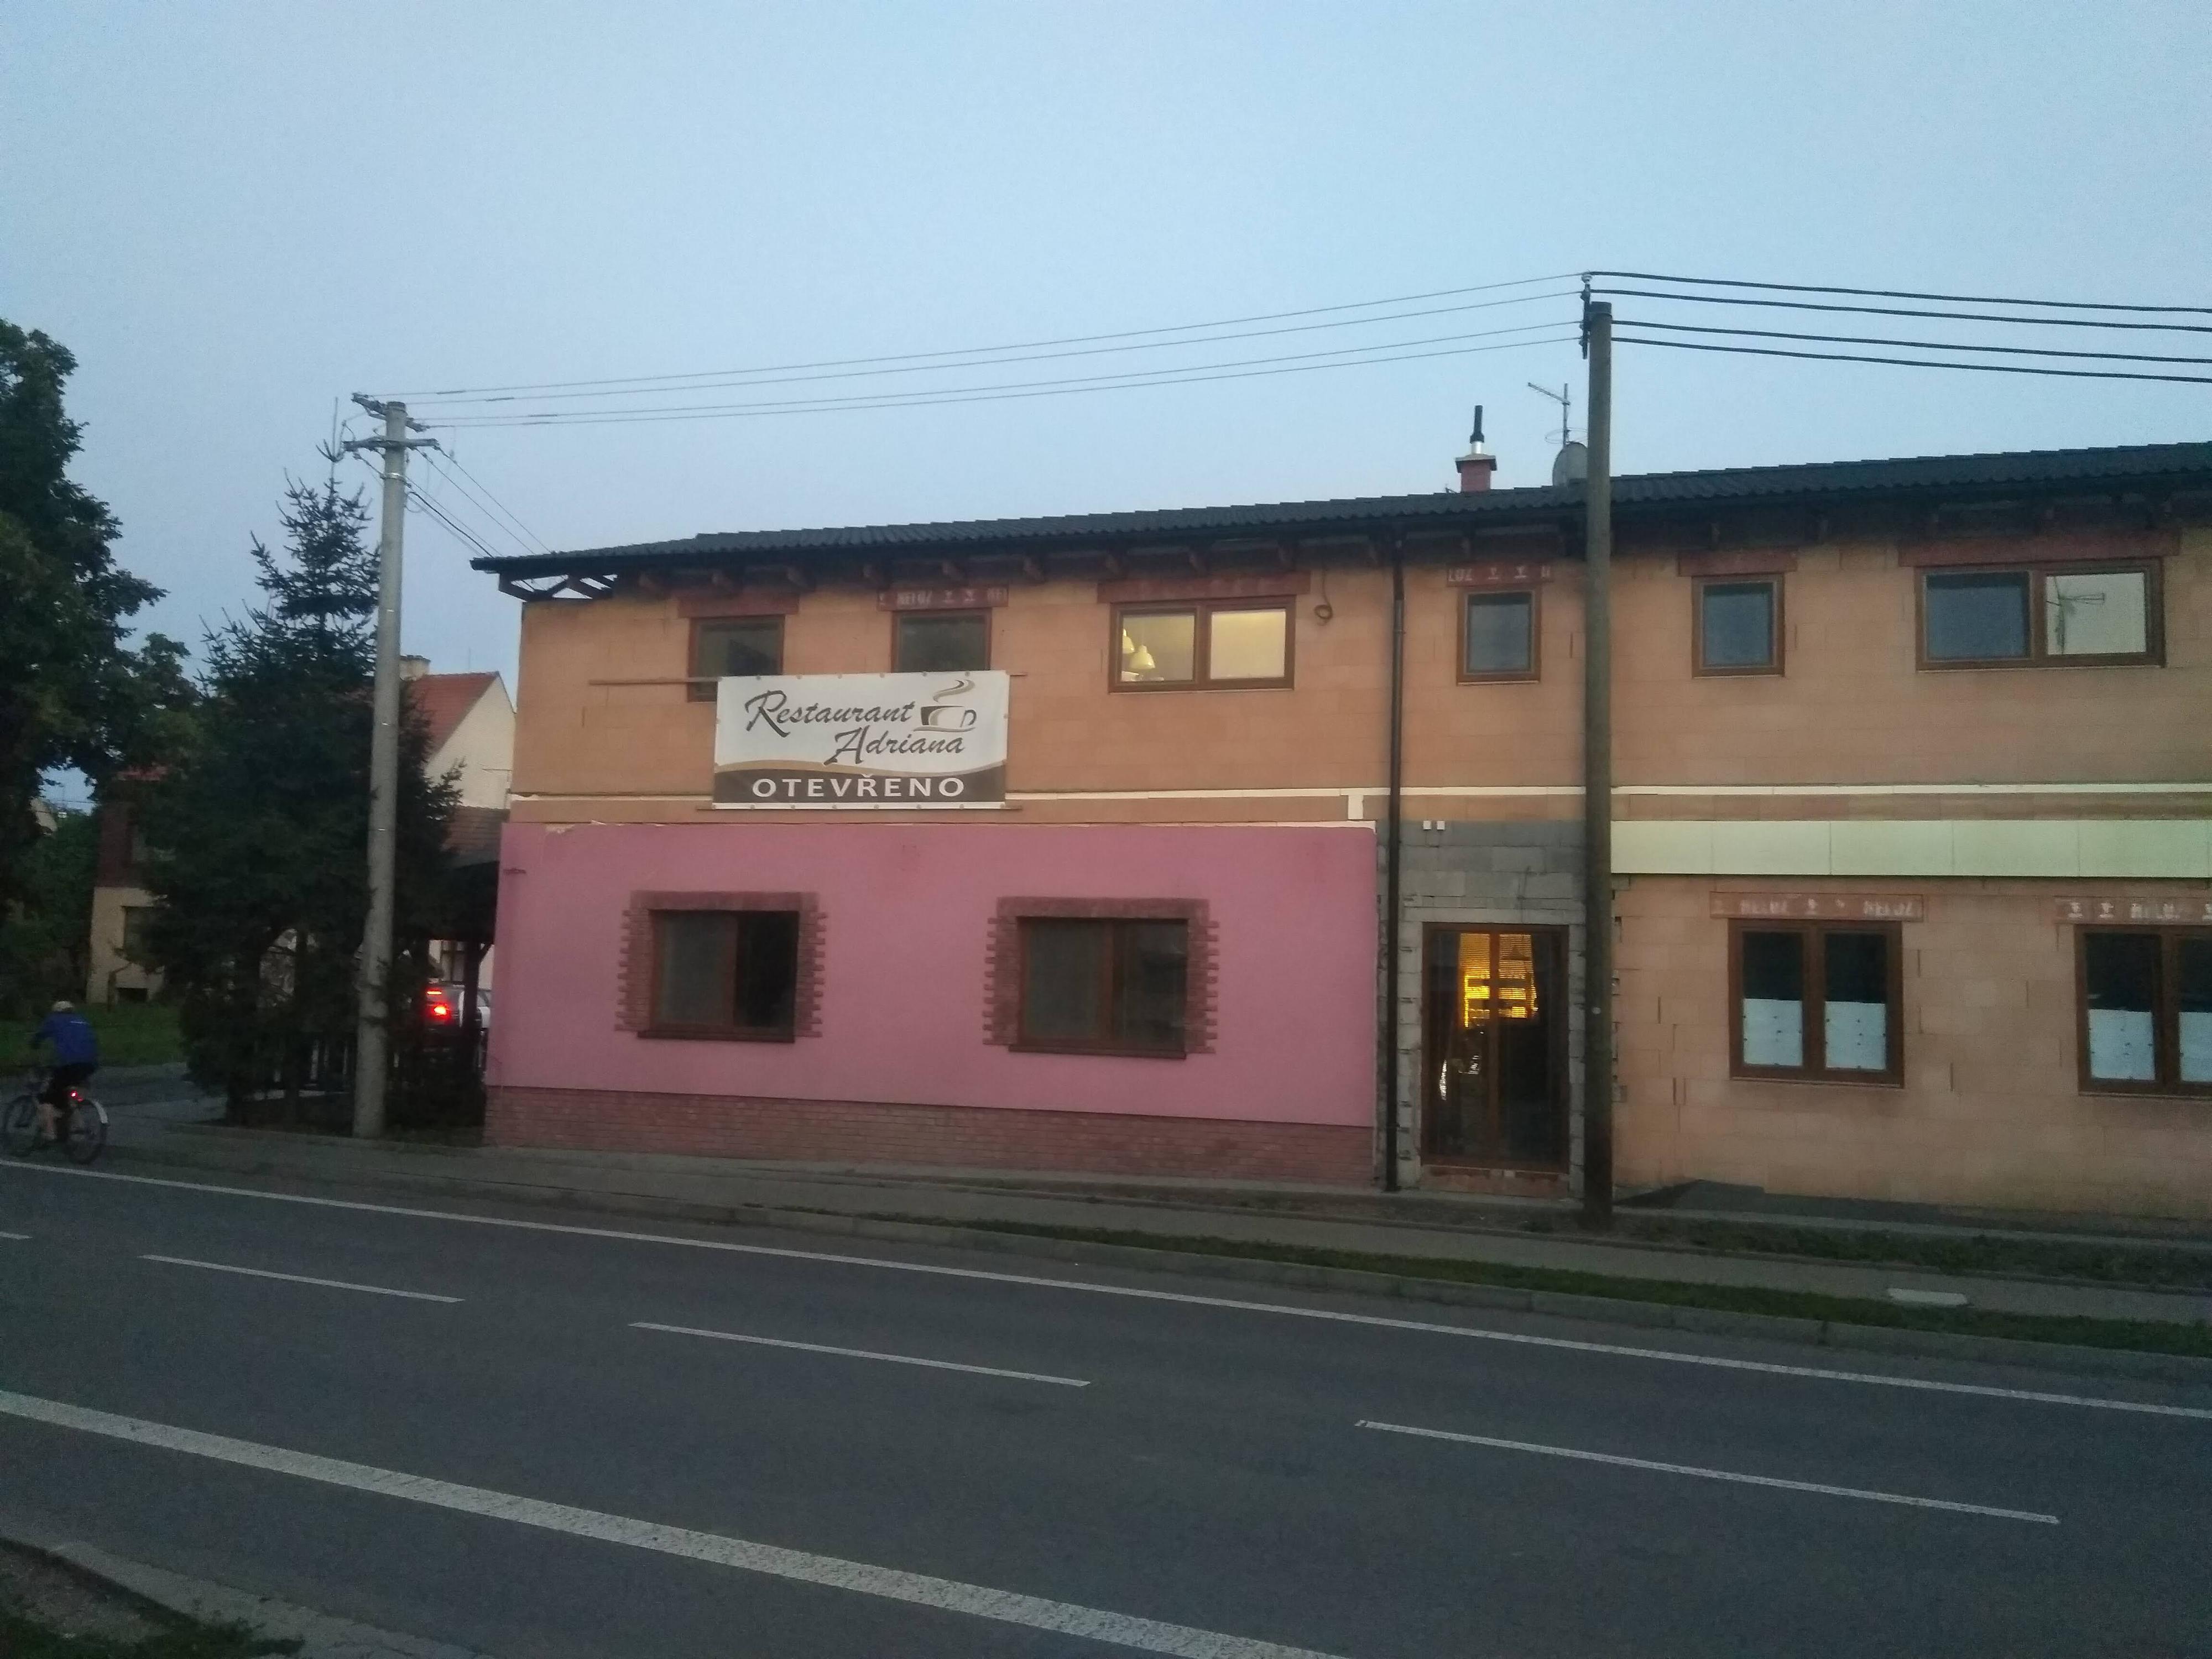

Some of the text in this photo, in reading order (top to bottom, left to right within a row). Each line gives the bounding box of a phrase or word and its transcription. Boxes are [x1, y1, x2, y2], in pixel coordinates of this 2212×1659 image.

[745, 690, 915, 738] Restaurant
[823, 725, 966, 766] Adriana
[752, 774, 964, 798] OTEVŘENO
